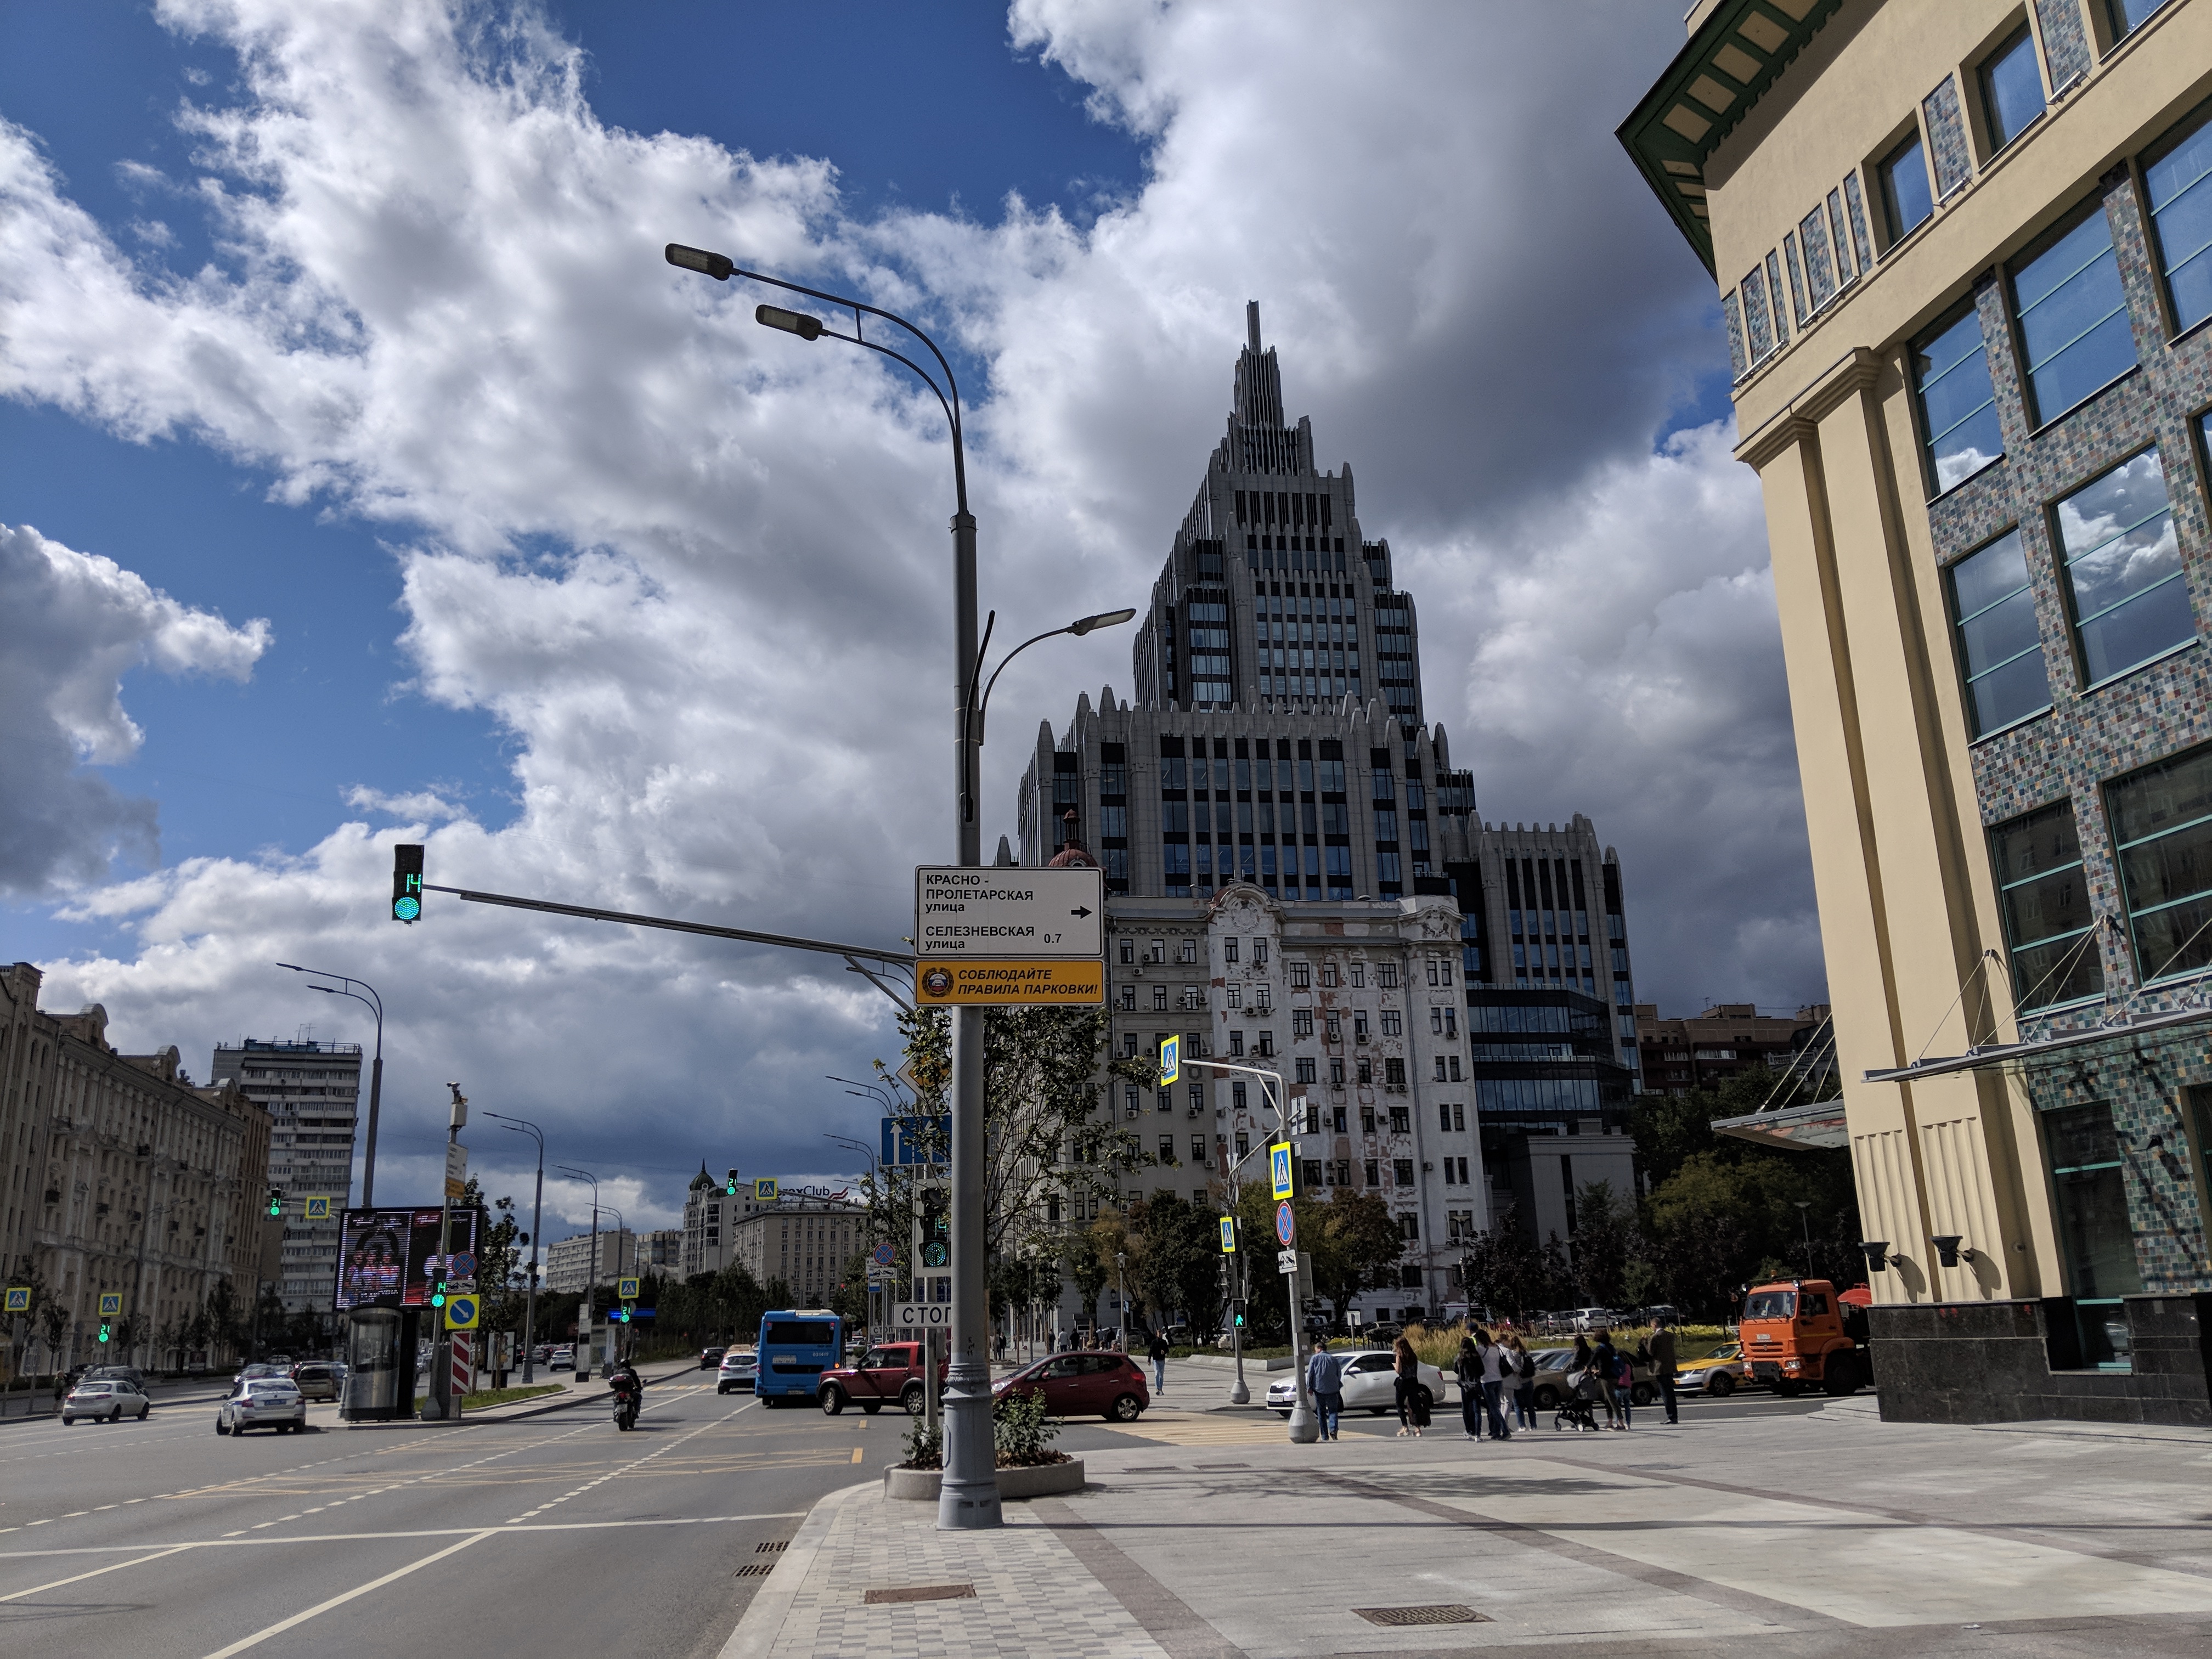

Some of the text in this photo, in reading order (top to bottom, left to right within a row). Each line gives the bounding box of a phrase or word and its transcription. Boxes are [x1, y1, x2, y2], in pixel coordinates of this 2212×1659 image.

[406, 873, 421, 893] 14
[926, 874, 980, 885] КРАСНО
[926, 889, 1034, 901] ПРОЛЕТАРСКАЯ
[925, 903, 965, 914] улица
[926, 926, 1035, 936] СЕЛЕЗНЕВСКАЯ
[1043, 934, 1062, 944] 0.7
[925, 940, 965, 951] улица
[958, 968, 1052, 981] СОБЛЮДАЙТЕ
[958, 984, 1098, 995] ПРАВИЛА ПАРКОВКИ!
[272, 1198, 281, 1206] 21
[100, 1325, 110, 1333] 21
